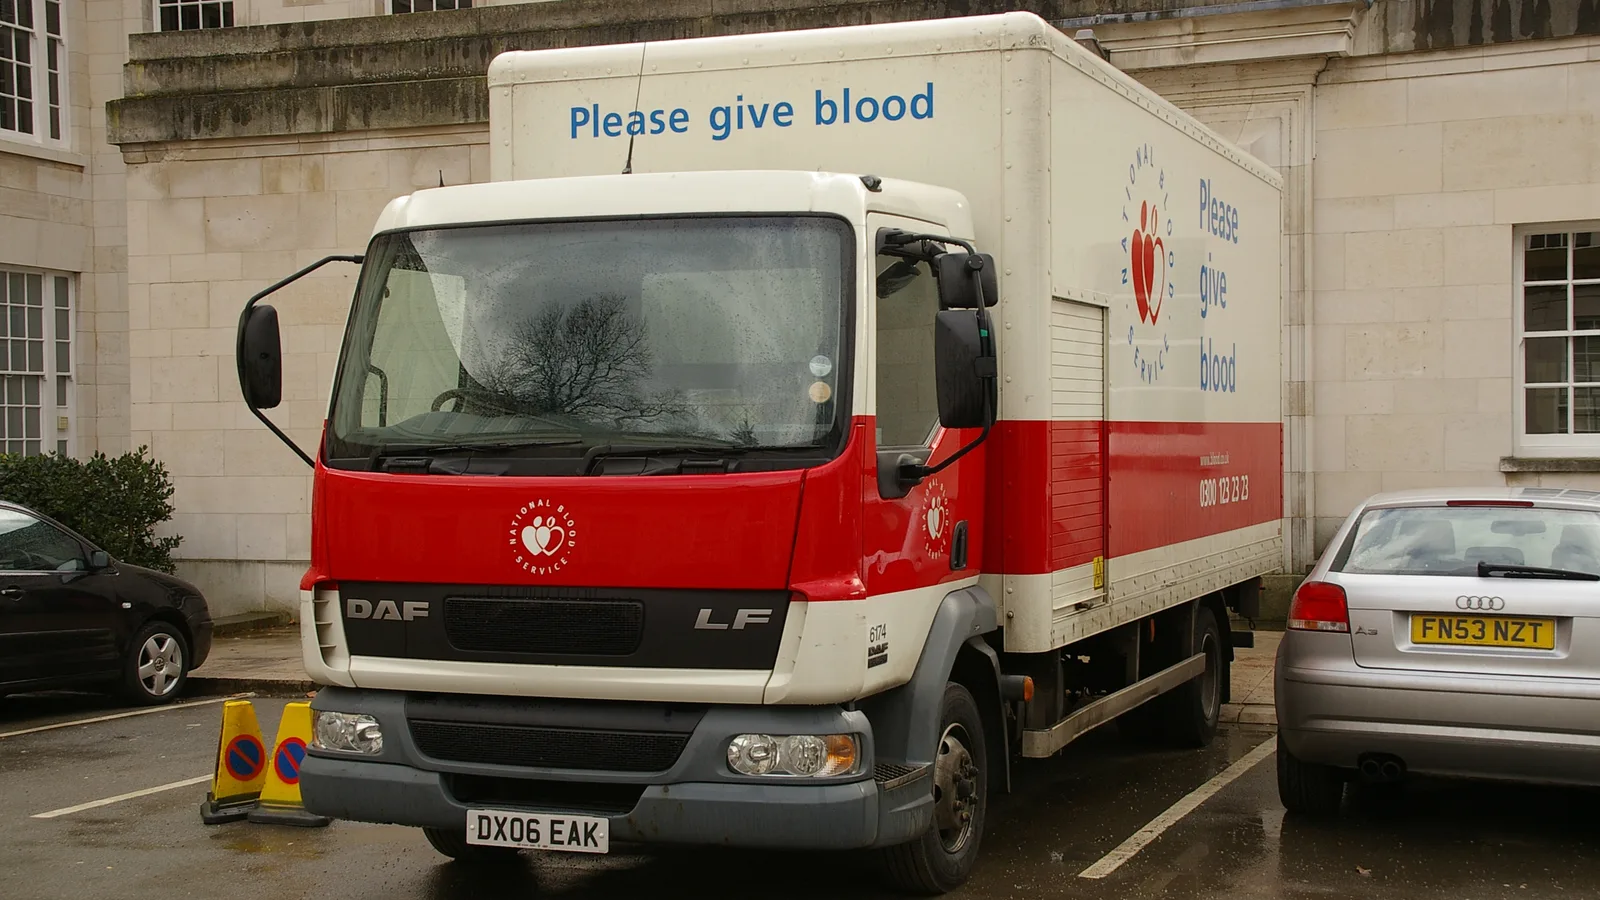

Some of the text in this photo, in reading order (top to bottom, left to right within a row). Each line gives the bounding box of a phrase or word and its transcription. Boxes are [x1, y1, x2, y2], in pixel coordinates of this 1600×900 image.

[570, 82, 934, 141] Please give blood
[1121, 143, 1174, 299] NATIONAL BLOOD
[1200, 178, 1239, 244] Please
[1200, 252, 1227, 319] give
[1127, 325, 1170, 385] SERVICE
[1200, 337, 1236, 394] blood
[1200, 474, 1249, 508] 0300 123 23 23
[509, 499, 577, 547] NATIONAL BLOOD
[515, 555, 568, 575] SERVICE
[347, 599, 430, 621] DAF
[694, 608, 773, 630] LF
[869, 623, 887, 643] 6174
[1355, 625, 1378, 636] A3
[1421, 618, 1543, 643] FN53 NZT
[477, 814, 599, 848] DX06 EAK
